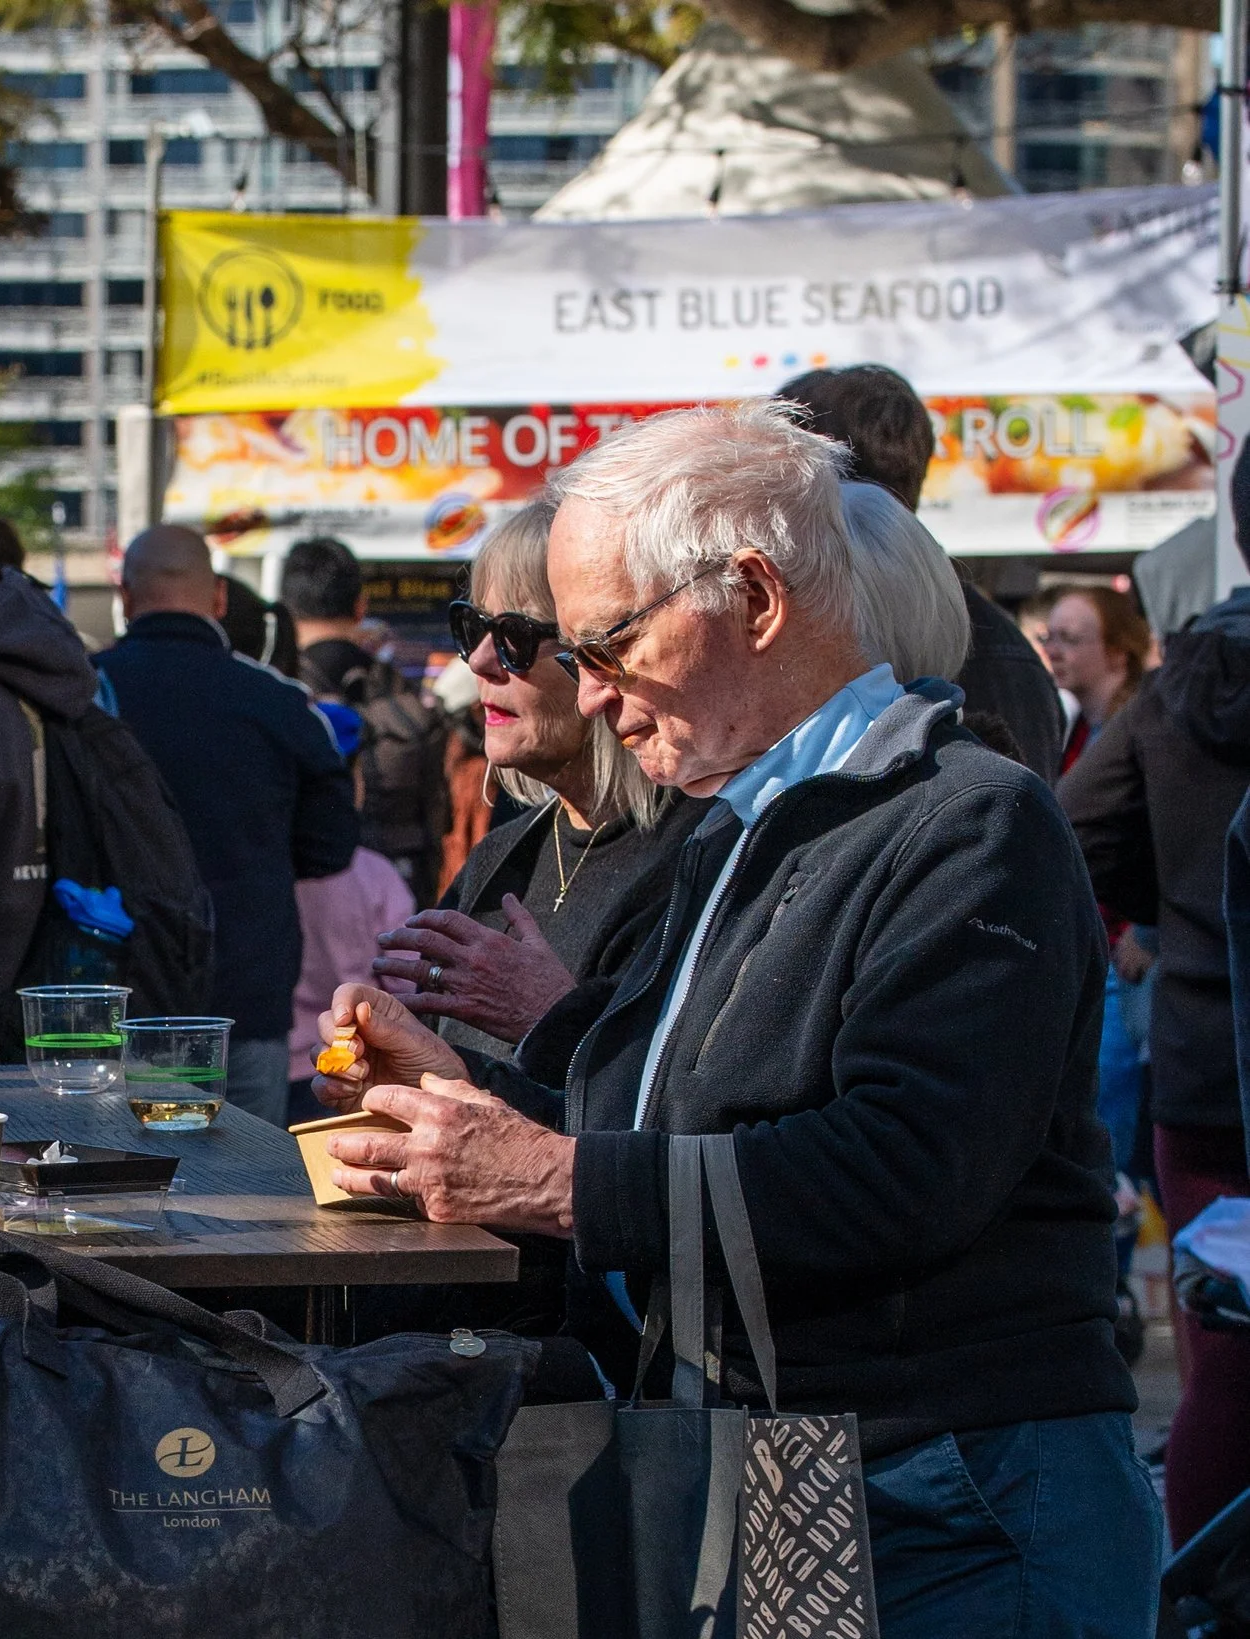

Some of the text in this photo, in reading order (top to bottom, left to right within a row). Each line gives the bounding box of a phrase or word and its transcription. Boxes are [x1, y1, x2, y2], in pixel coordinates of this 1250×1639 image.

[553, 275, 1005, 334] EAST BLUE SEAFOOD
[322, 415, 491, 468] HOME
[502, 413, 579, 467] OF
[962, 406, 1103, 460] ROLL
[108, 1487, 271, 1507] THE LANGHAM
[163, 1516, 221, 1528] London
[780, 1457, 840, 1527] BLOCH
[768, 1516, 820, 1582] BLOCH
[786, 1569, 851, 1638] BLOCH
